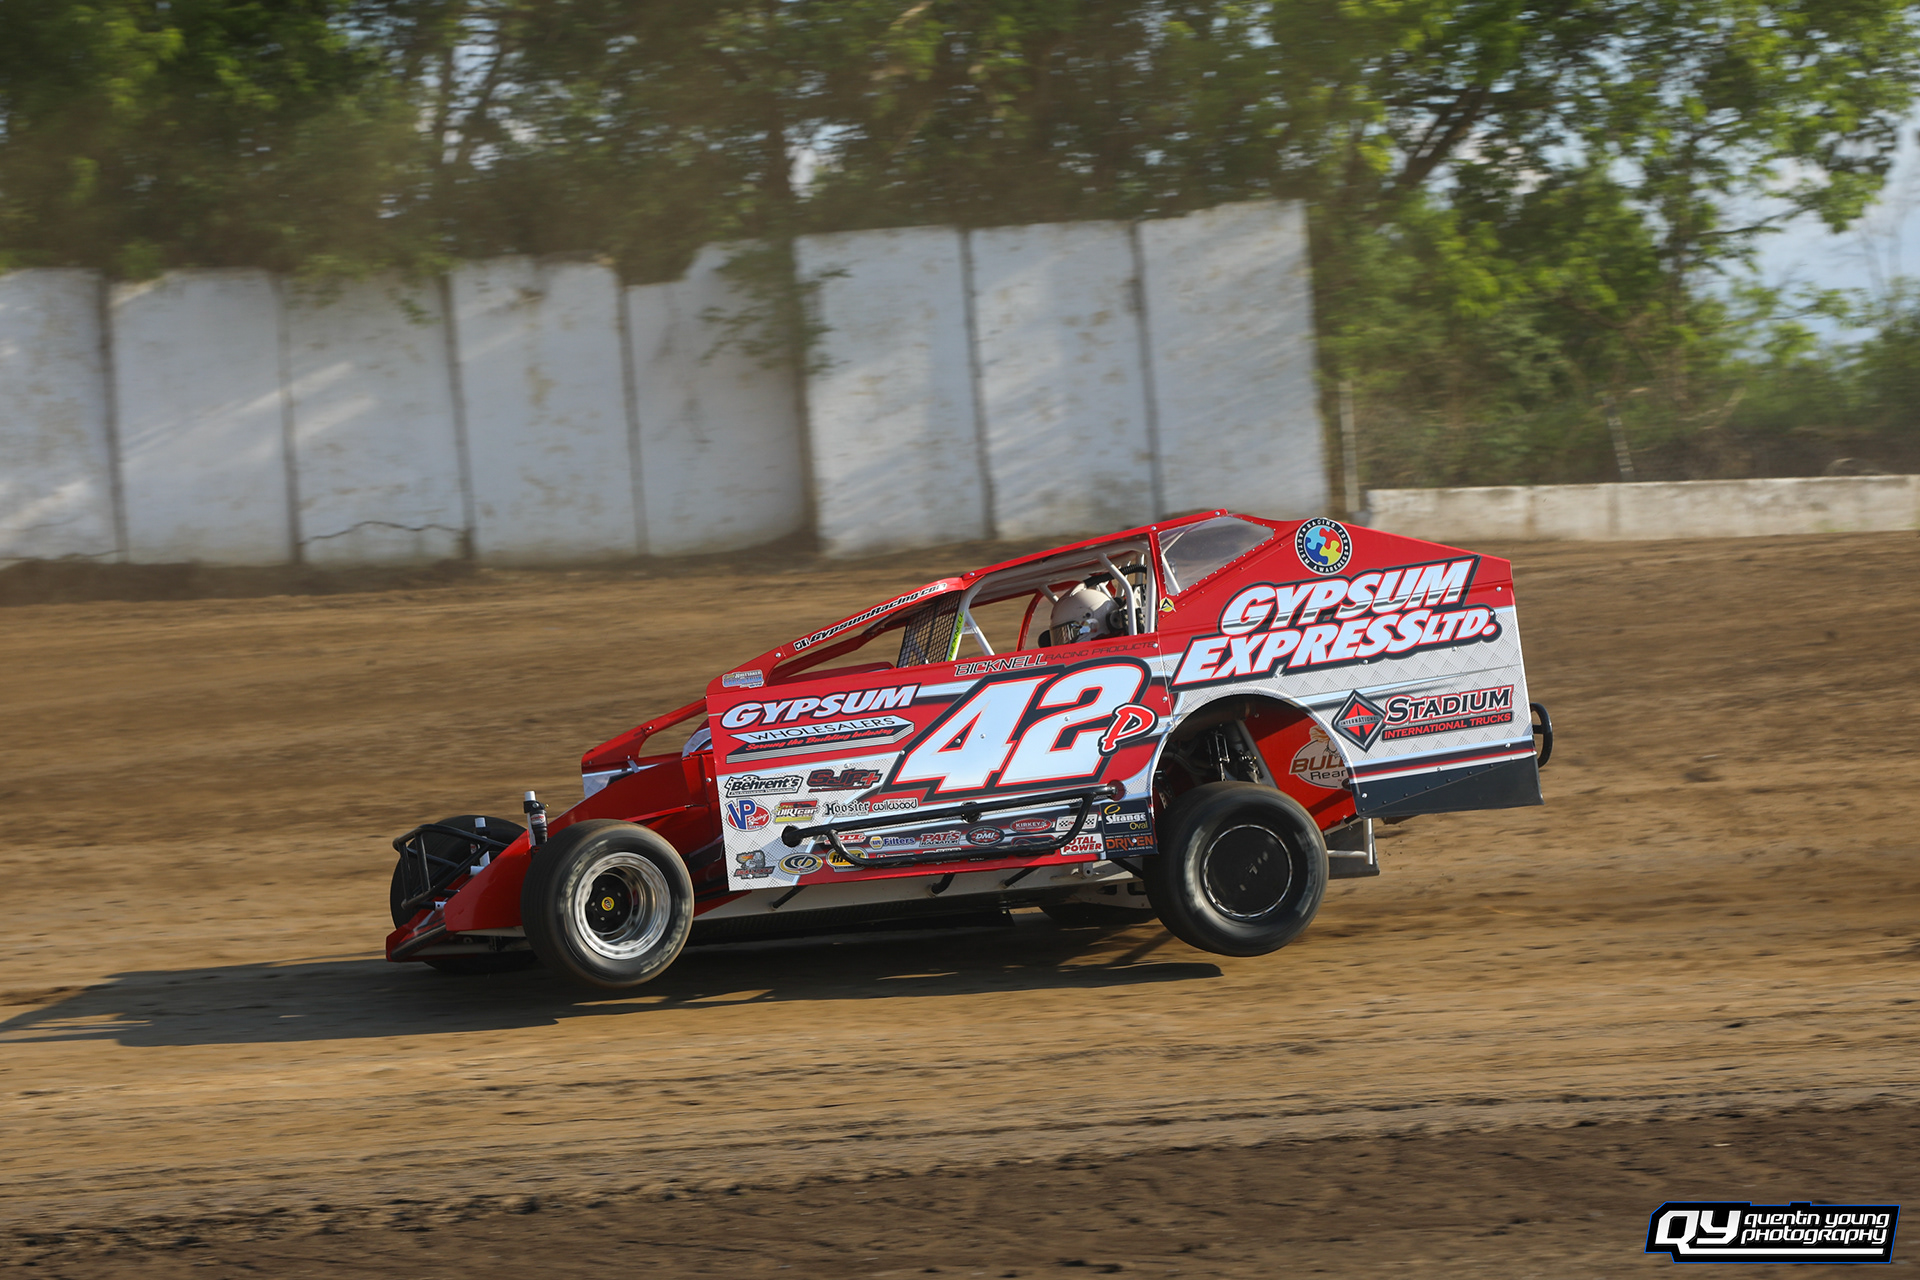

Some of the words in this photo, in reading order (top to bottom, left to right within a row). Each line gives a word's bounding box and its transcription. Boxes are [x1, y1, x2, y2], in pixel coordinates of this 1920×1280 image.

[1306, 519, 1336, 529] RACING
[1338, 529, 1349, 544] FOR
[1297, 533, 1311, 564] AUTISM
[1312, 551, 1350, 573] AWARENESS
[1221, 558, 1476, 635] GYPSUM
[954, 654, 1047, 677] BICKNELL
[1045, 649, 1089, 660] RACING
[1092, 641, 1155, 655] PRODUCTS
[722, 684, 920, 728] GYPSUM
[1384, 686, 1514, 724] STADIUM
[1339, 716, 1380, 726] INTERNATIONAL
[1383, 722, 1469, 741] INTERNATIONAL
[1470, 713, 1512, 728] TRUCKS
[748, 717, 896, 741] WHOLESALERS
[746, 740, 785, 751] Serving
[787, 738, 804, 746] the
[805, 733, 851, 747] Building
[851, 727, 894, 740] Industry
[1310, 769, 1347, 781] Rear
[730, 777, 800, 792] Behrent's
[823, 801, 870, 816] Hoosier
[872, 798, 918, 812] wilwood
[728, 799, 756, 830] VP
[1105, 812, 1147, 825] Strange
[1129, 821, 1148, 830] Oval
[884, 837, 915, 847] Filters
[921, 838, 959, 847] RADIATOR
[922, 831, 961, 843] PAT'S
[976, 832, 996, 840] DMI
[1066, 836, 1096, 846] OTAL
[1105, 835, 1154, 851] DRIVEN
[1063, 842, 1103, 853] POWER
